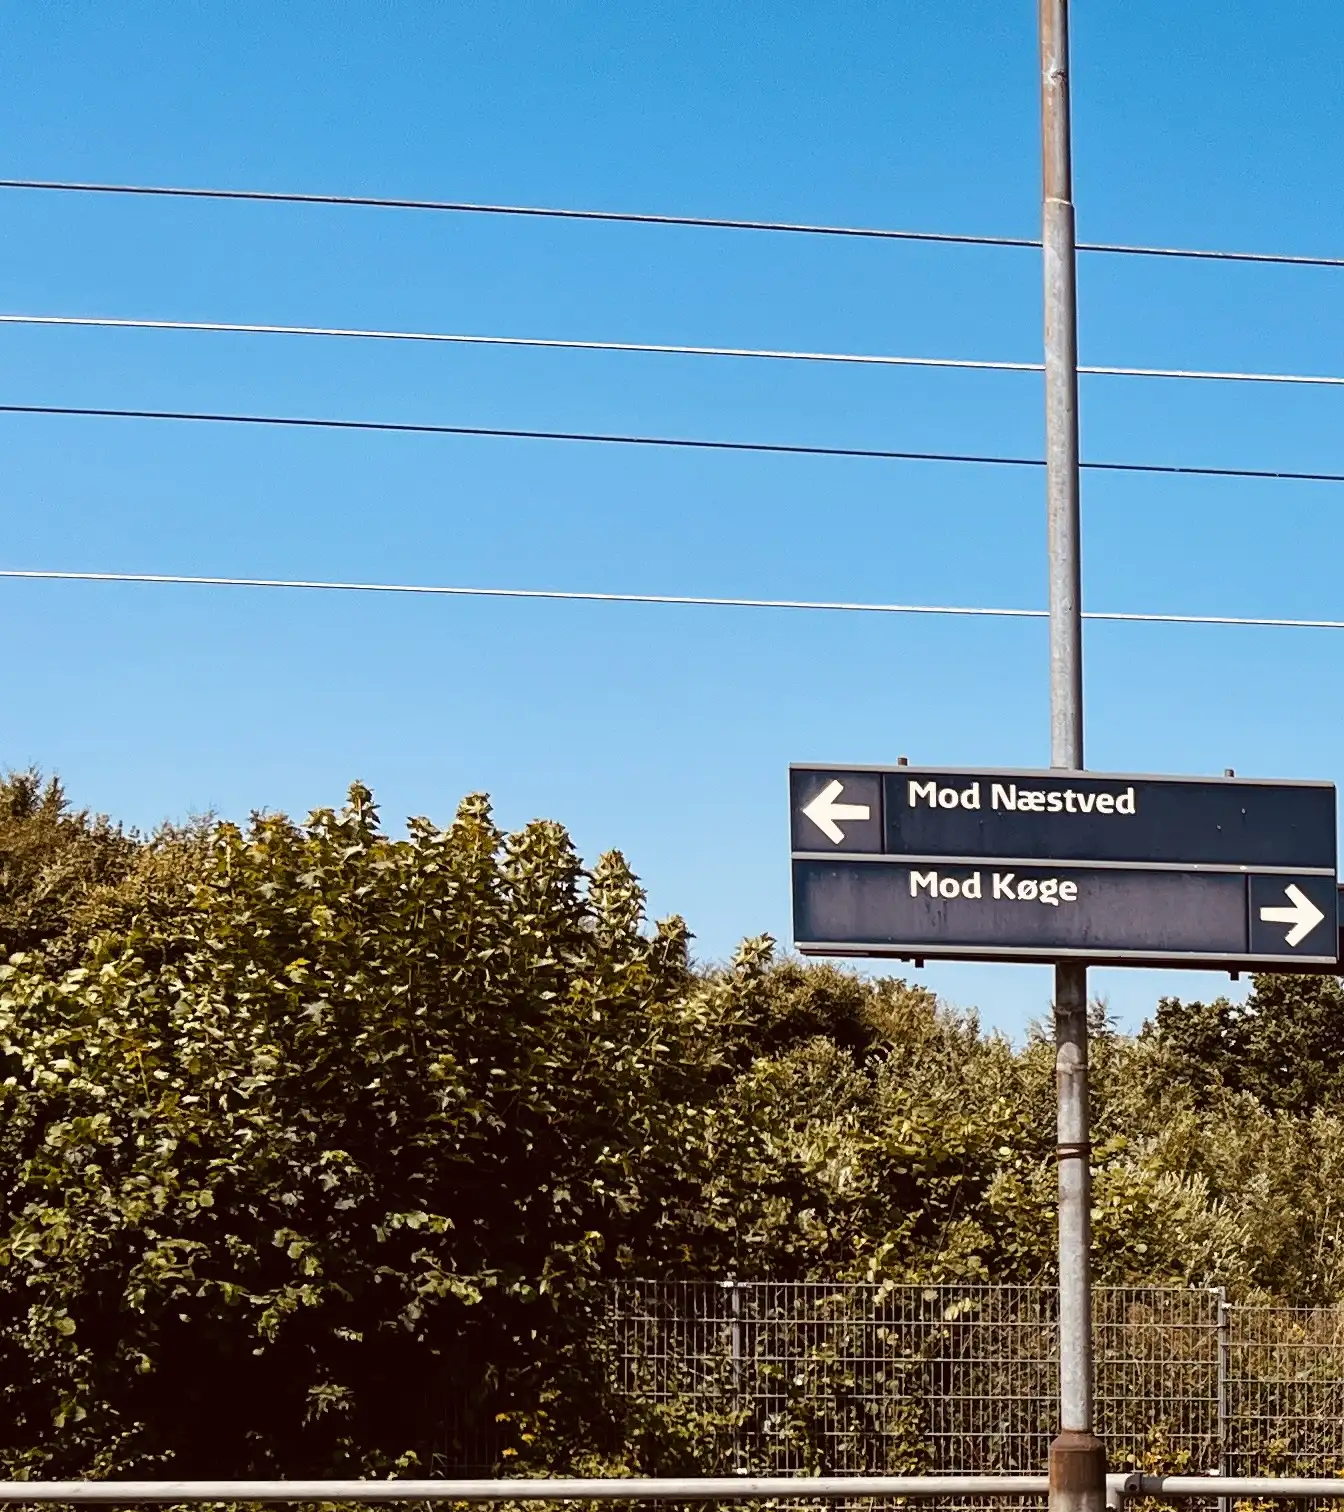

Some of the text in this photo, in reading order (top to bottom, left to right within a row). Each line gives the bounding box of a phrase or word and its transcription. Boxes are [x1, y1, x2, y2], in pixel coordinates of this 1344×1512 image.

[908, 780, 1136, 814] Mod Næstved
[909, 871, 1077, 906] Mod Køge
